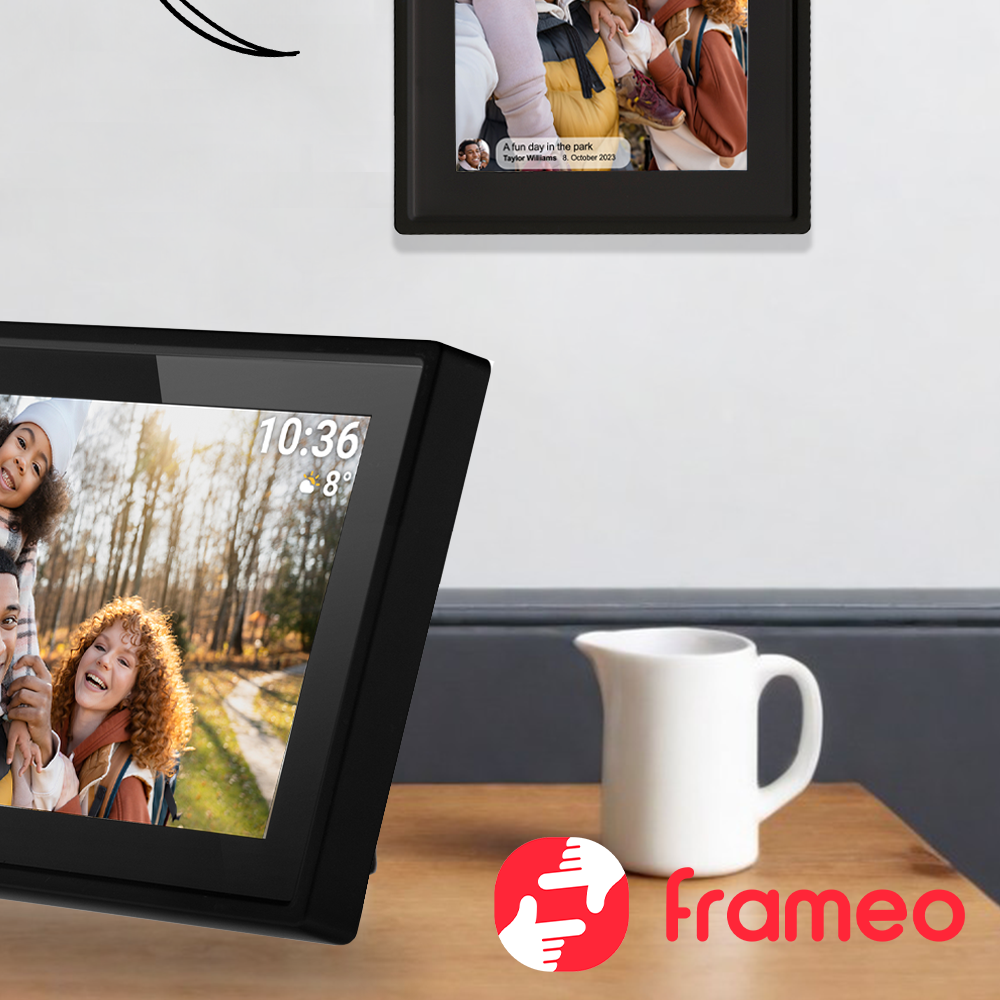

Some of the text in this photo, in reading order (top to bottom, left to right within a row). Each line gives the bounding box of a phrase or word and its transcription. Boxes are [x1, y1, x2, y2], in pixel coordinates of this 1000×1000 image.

[503, 142, 593, 153] A fun day in the park
[503, 154, 616, 163] Taylor Williams 8. October 2023
[260, 416, 360, 459] 10:36
